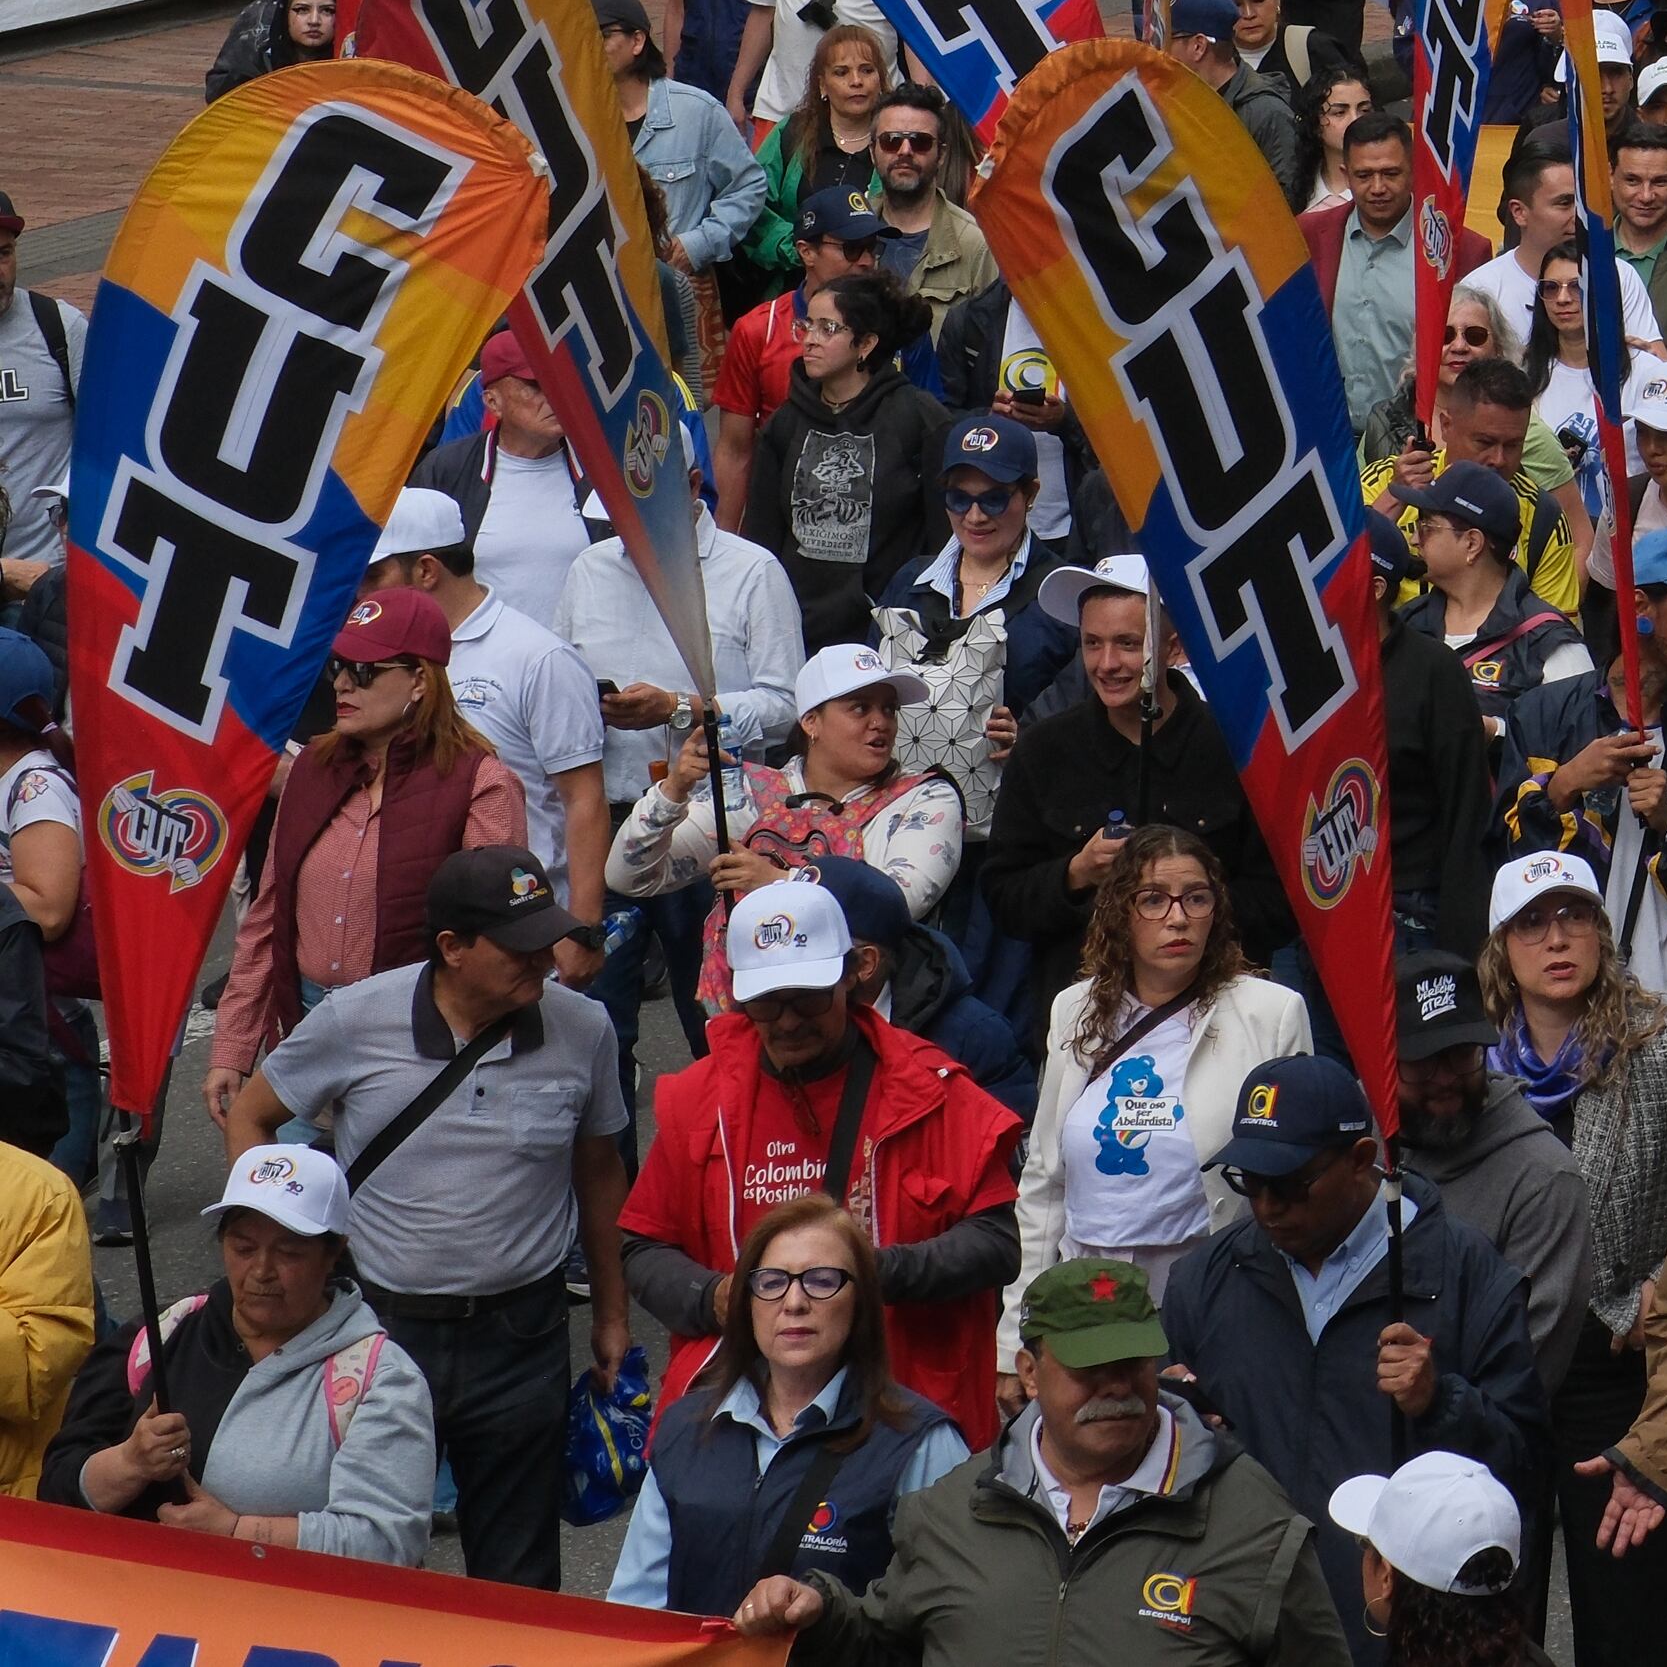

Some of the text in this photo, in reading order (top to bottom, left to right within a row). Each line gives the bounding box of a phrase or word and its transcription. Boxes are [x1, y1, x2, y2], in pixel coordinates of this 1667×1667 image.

[104, 101, 470, 744] CUT
[1040, 70, 1356, 758] CUT
[803, 527, 854, 541] EXIGIMOS
[126, 797, 196, 865] CUT
[1317, 792, 1360, 879] CUT
[1416, 974, 1453, 994] NI UN
[1416, 983, 1456, 1003] DERECHO
[1421, 993, 1455, 1016] ATRÁS
[1125, 1099, 1166, 1111] Que oso
[1136, 1108, 1152, 1116] ser
[1114, 1116, 1173, 1127] Abelardista
[766, 1141, 796, 1158] Otra
[744, 1158, 828, 1186] Colombi
[743, 1182, 811, 1205] es Posible
